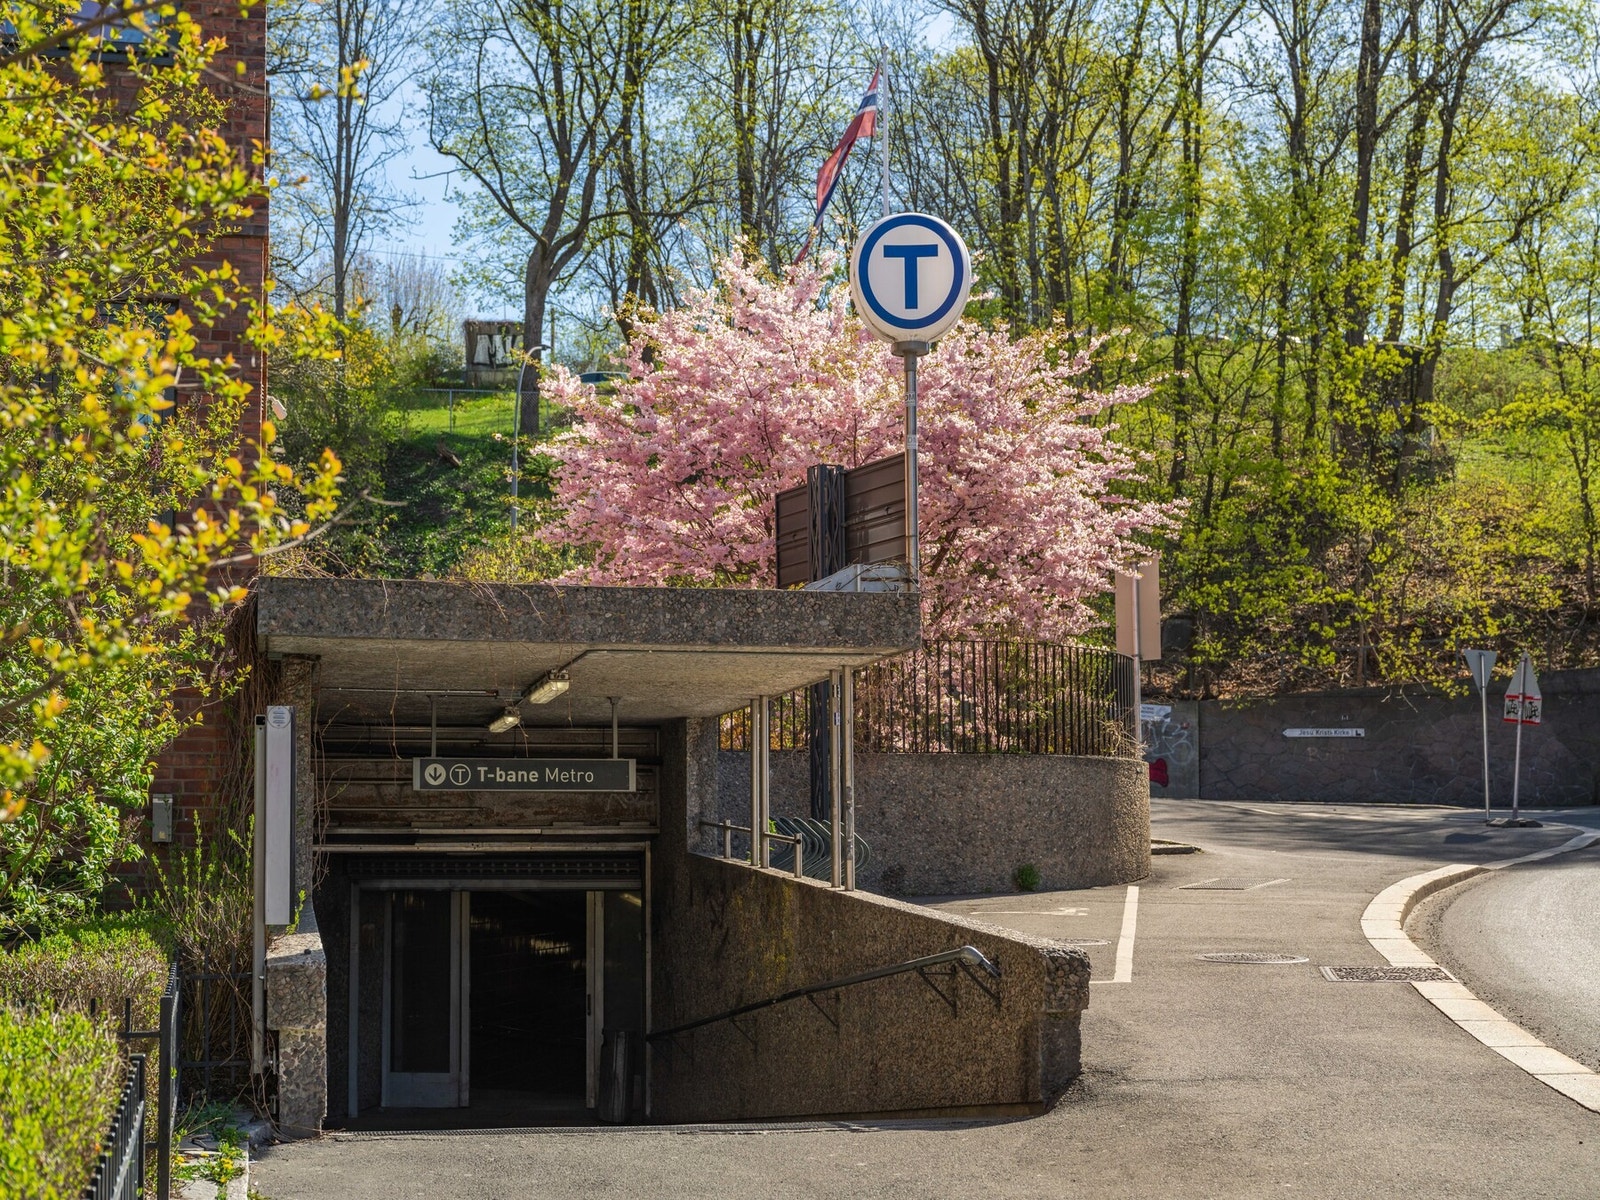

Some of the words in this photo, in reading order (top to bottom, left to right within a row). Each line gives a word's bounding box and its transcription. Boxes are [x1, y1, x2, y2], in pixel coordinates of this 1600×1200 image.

[883, 244, 938, 310] T
[455, 769, 466, 783] T
[477, 766, 539, 783] T-bane
[545, 767, 594, 783] Metro
